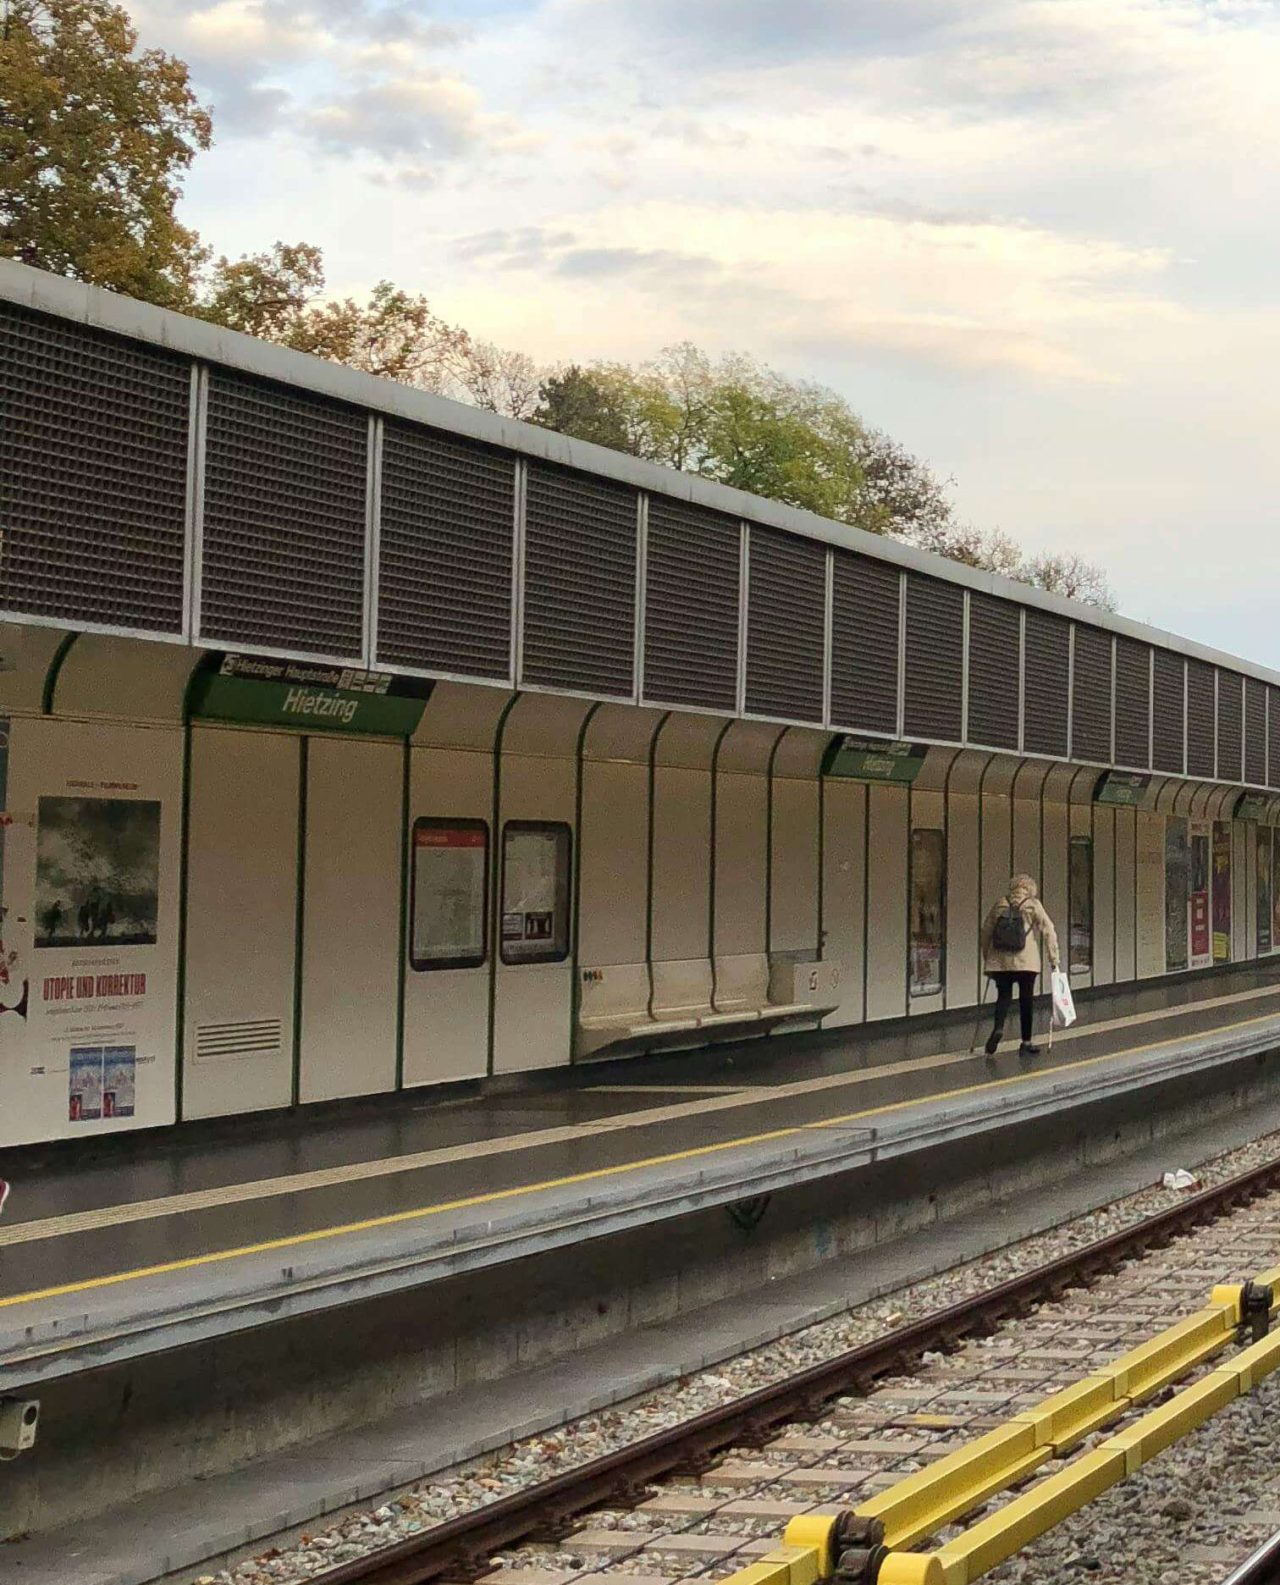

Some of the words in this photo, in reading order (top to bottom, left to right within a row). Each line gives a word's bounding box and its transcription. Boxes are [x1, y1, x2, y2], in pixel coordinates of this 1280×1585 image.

[282, 688, 358, 722] Hietzing
[43, 976, 74, 1000] UTOPIE
[76, 975, 94, 998] UND
[96, 973, 146, 997] KORREKTUR
